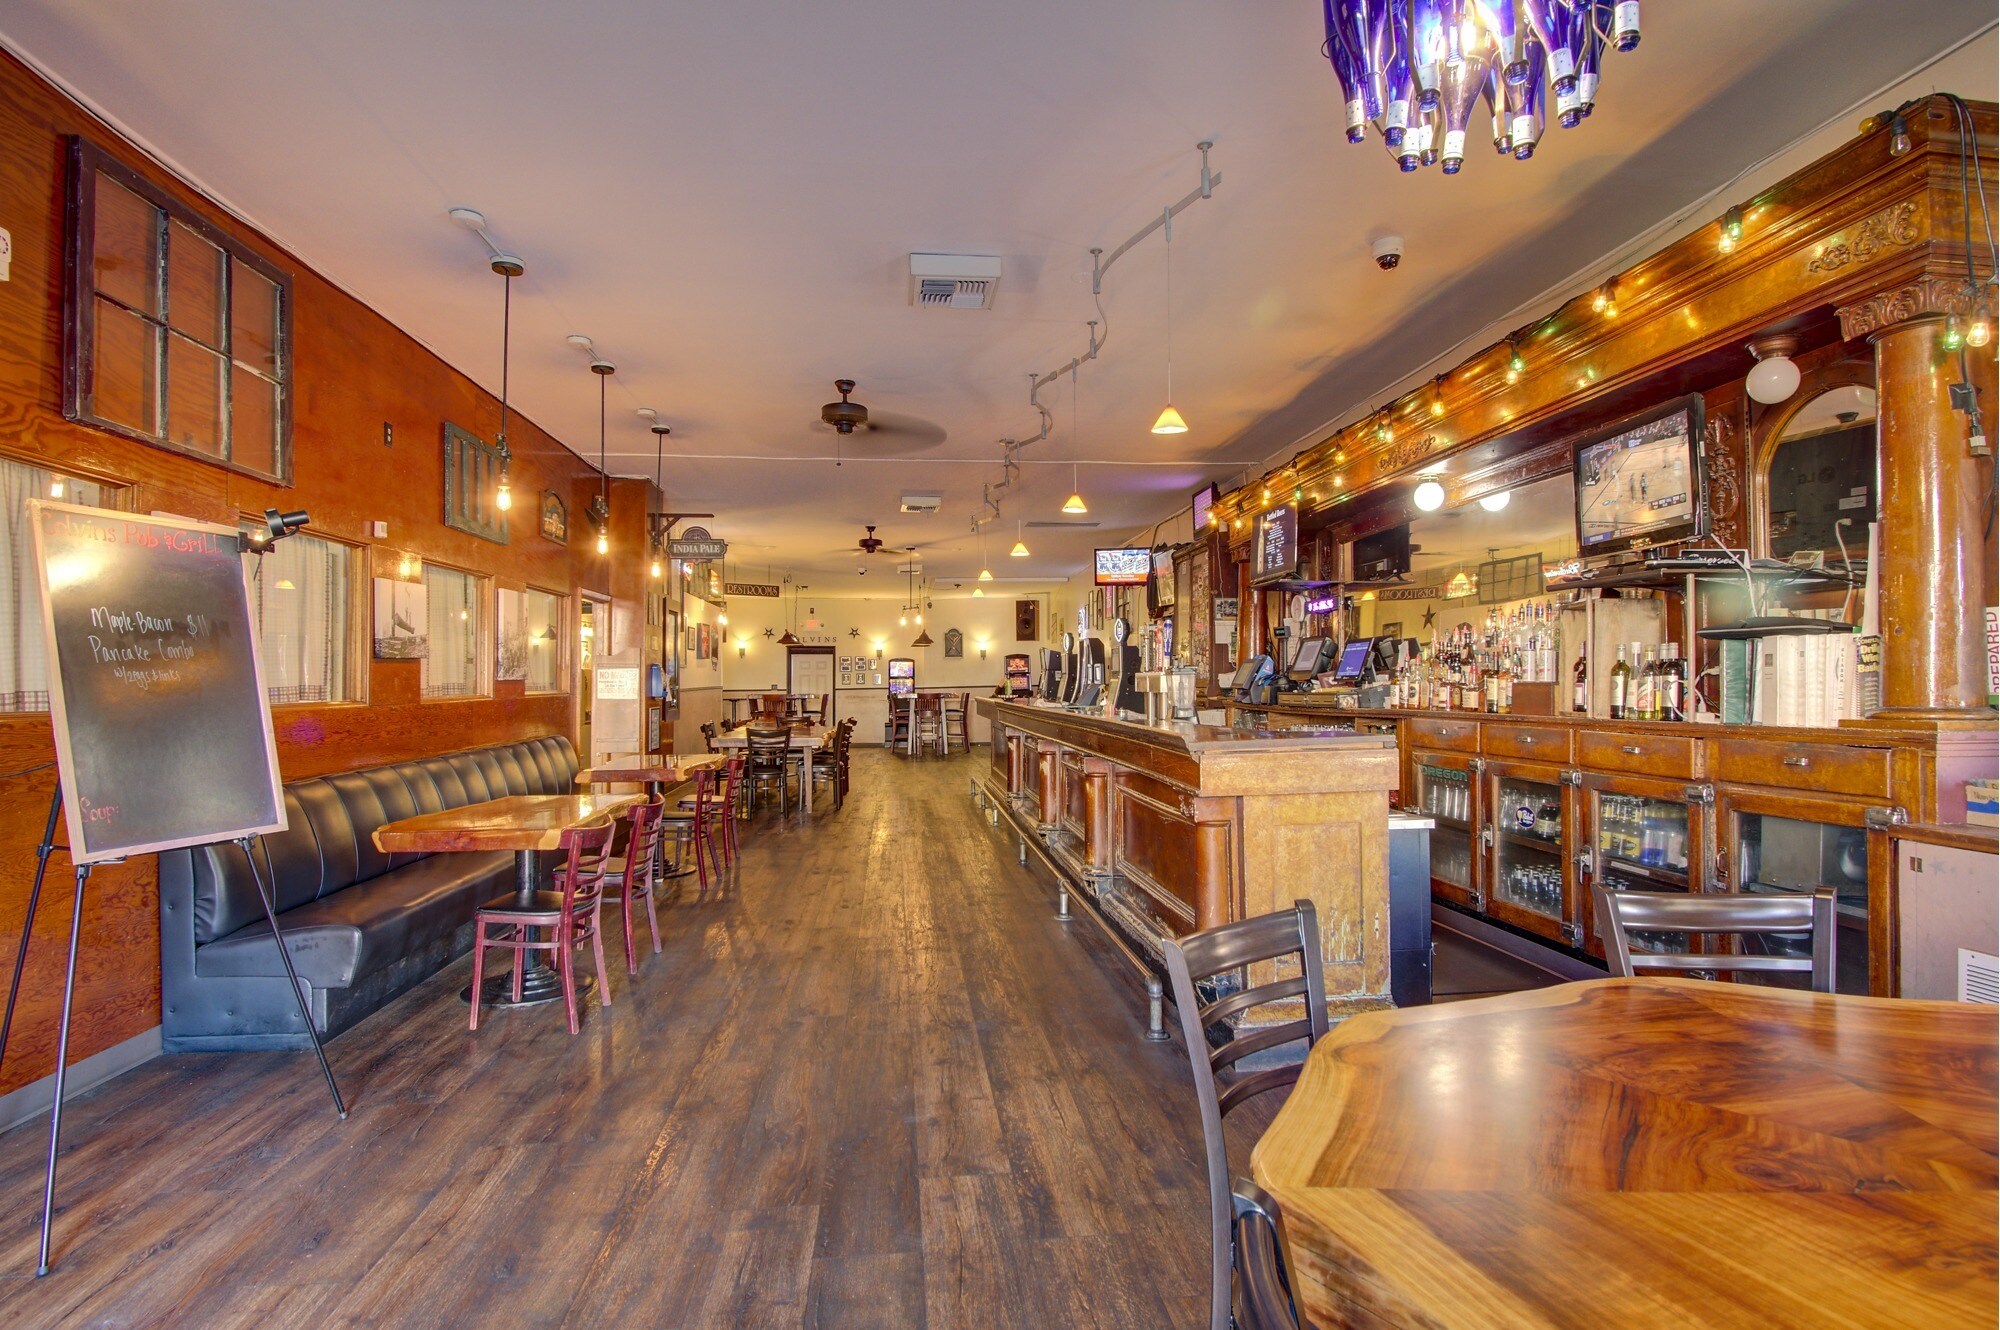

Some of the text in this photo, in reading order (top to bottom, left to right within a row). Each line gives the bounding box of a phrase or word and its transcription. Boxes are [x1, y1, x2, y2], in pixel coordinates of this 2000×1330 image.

[123, 523, 160, 548] Pub
[673, 544, 720, 554] INDIA PALE
[727, 585, 778, 597] RESTROOMS
[91, 606, 174, 634] Maple-Bacon
[88, 635, 195, 664] Pancake Combo
[1420, 765, 1468, 782] OREGON
